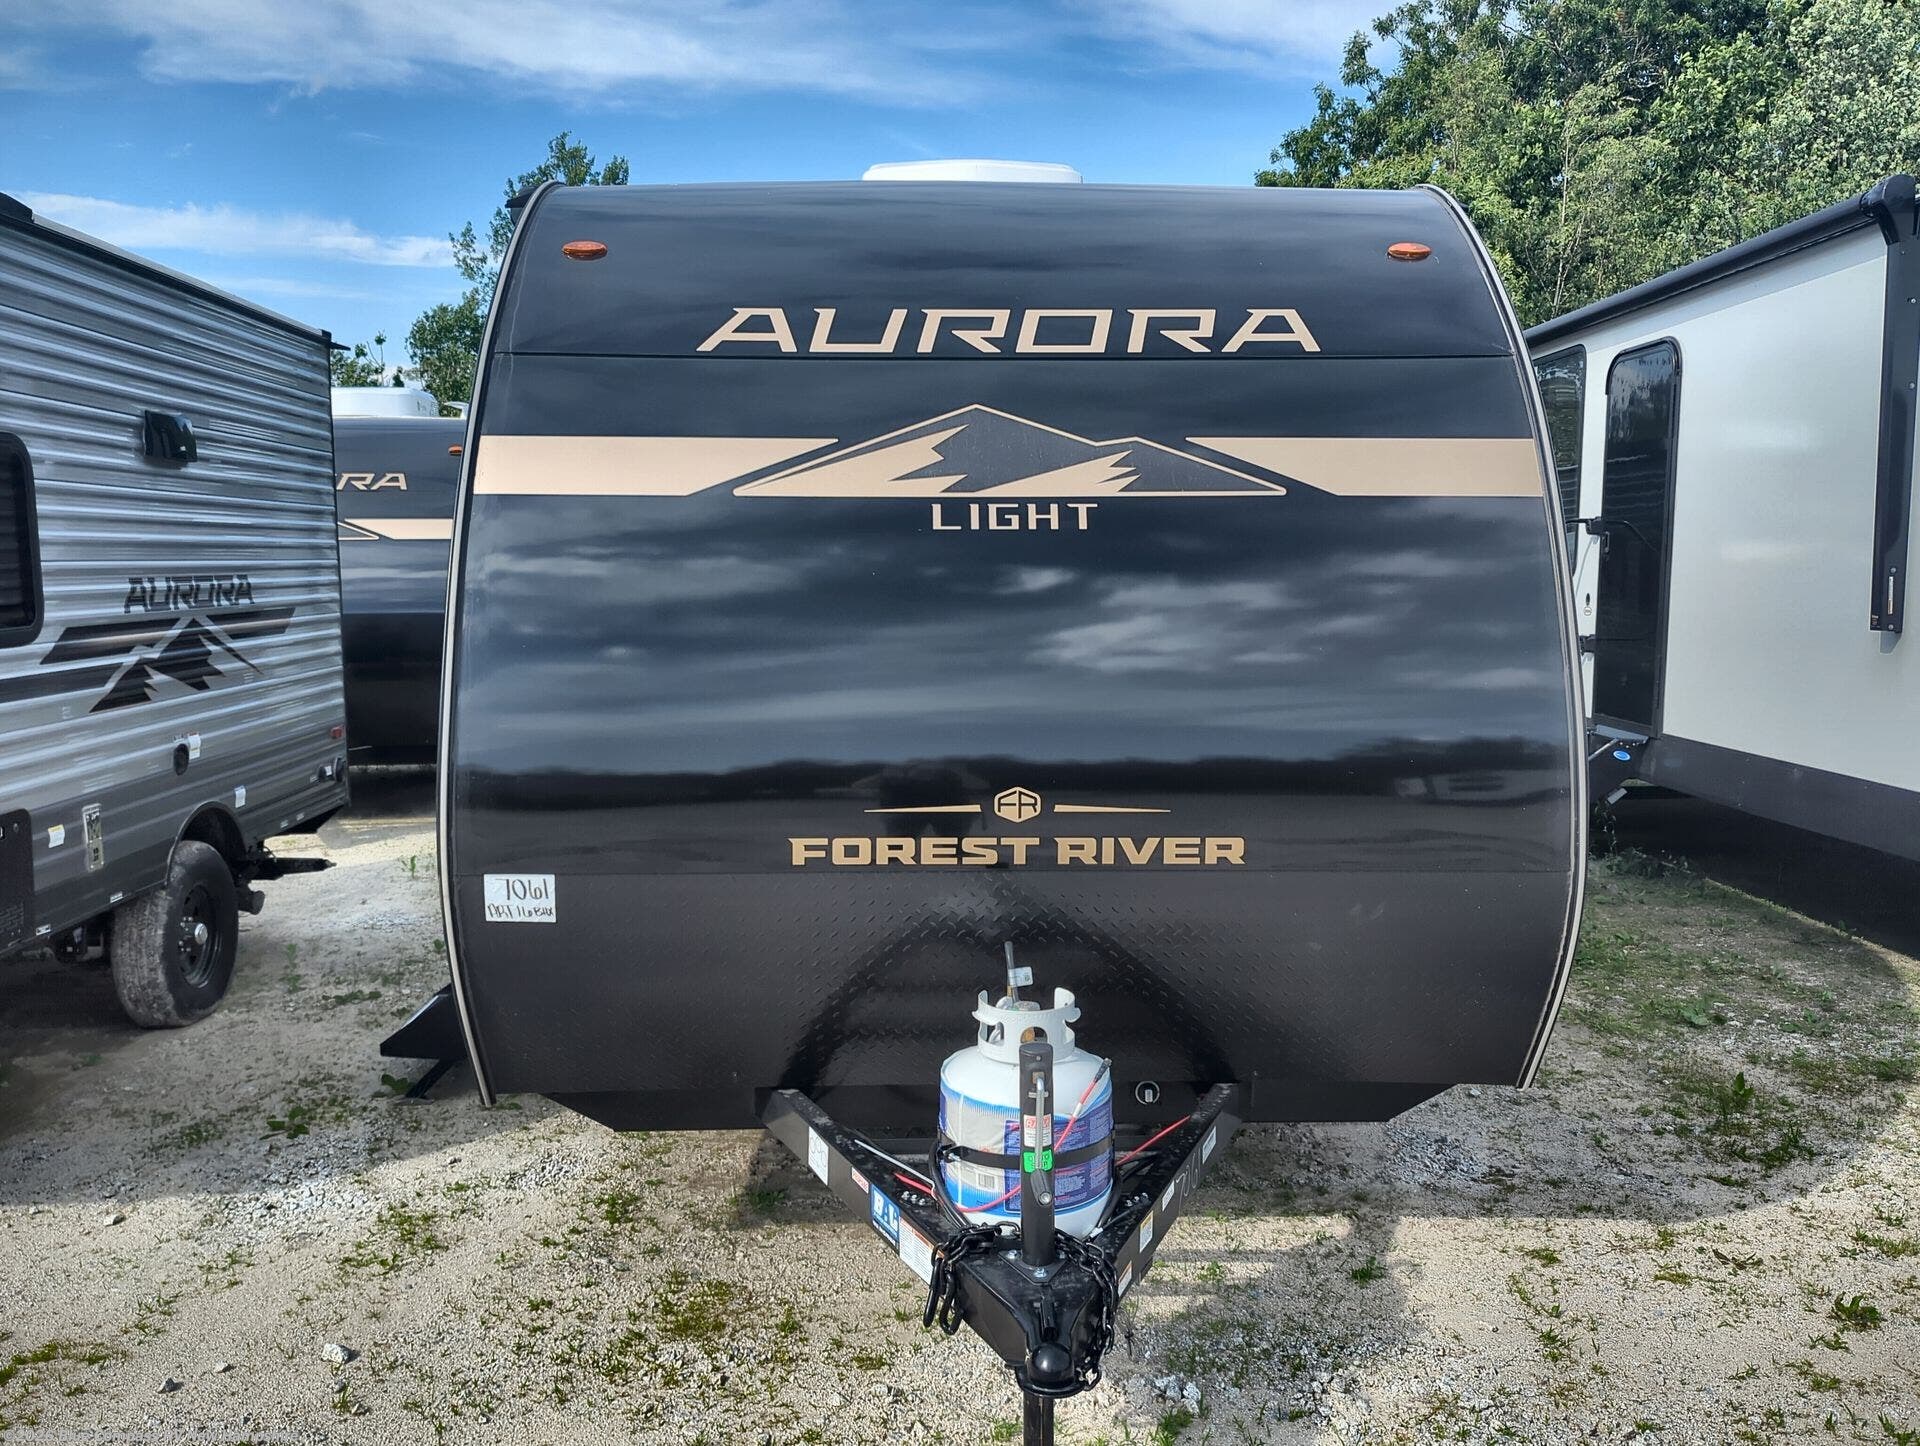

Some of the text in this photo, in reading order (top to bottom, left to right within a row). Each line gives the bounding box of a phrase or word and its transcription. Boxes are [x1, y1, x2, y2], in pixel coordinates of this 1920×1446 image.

[696, 308, 1321, 353] AURORA
[335, 472, 408, 491] RA
[931, 503, 1098, 531] LIGHT
[124, 574, 255, 613] AURORA
[788, 837, 1246, 866] FOREST RIVER
[494, 877, 550, 901] 7061
